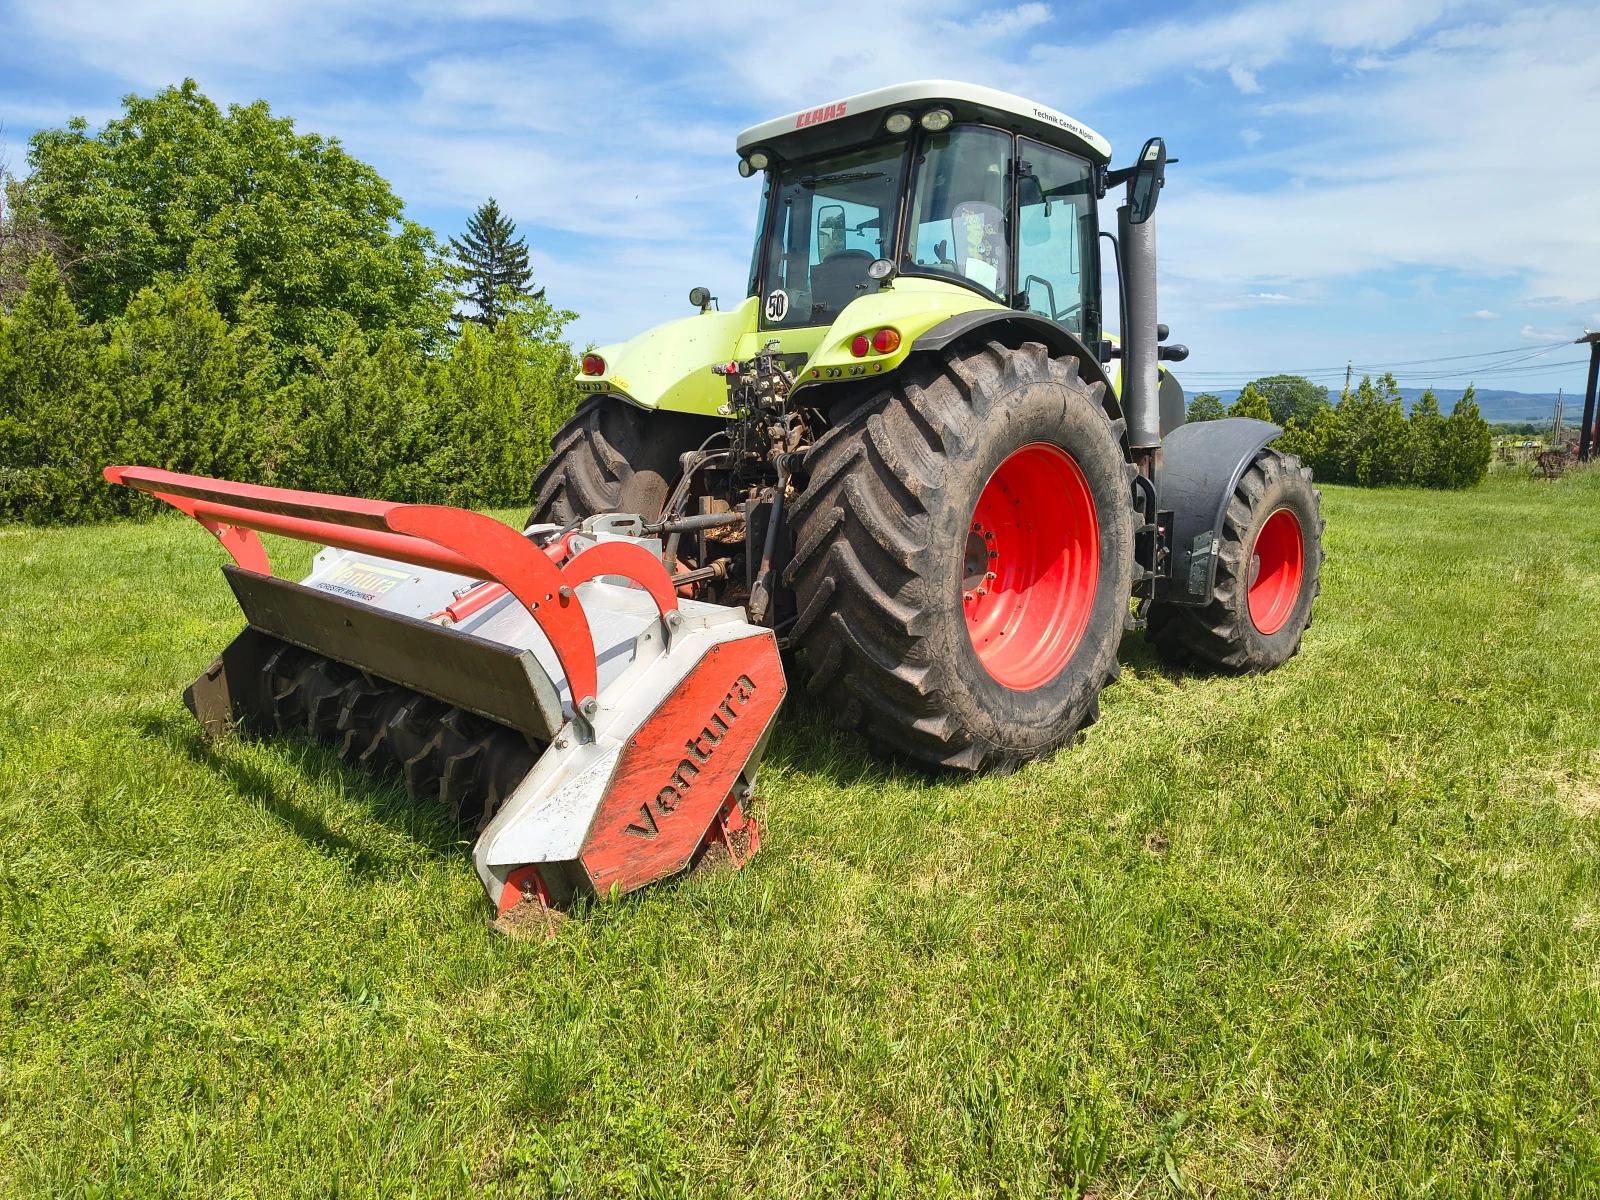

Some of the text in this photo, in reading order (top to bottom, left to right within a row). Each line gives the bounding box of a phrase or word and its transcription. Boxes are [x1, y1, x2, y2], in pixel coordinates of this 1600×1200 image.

[796, 101, 847, 128] CLAAS
[1033, 108, 1058, 124] Technik
[1059, 119, 1078, 132] Center
[768, 293, 785, 318] 50
[327, 559, 409, 595] Ventura
[316, 582, 378, 603] FORESTRY MACHINES
[624, 673, 757, 841] Ventura
